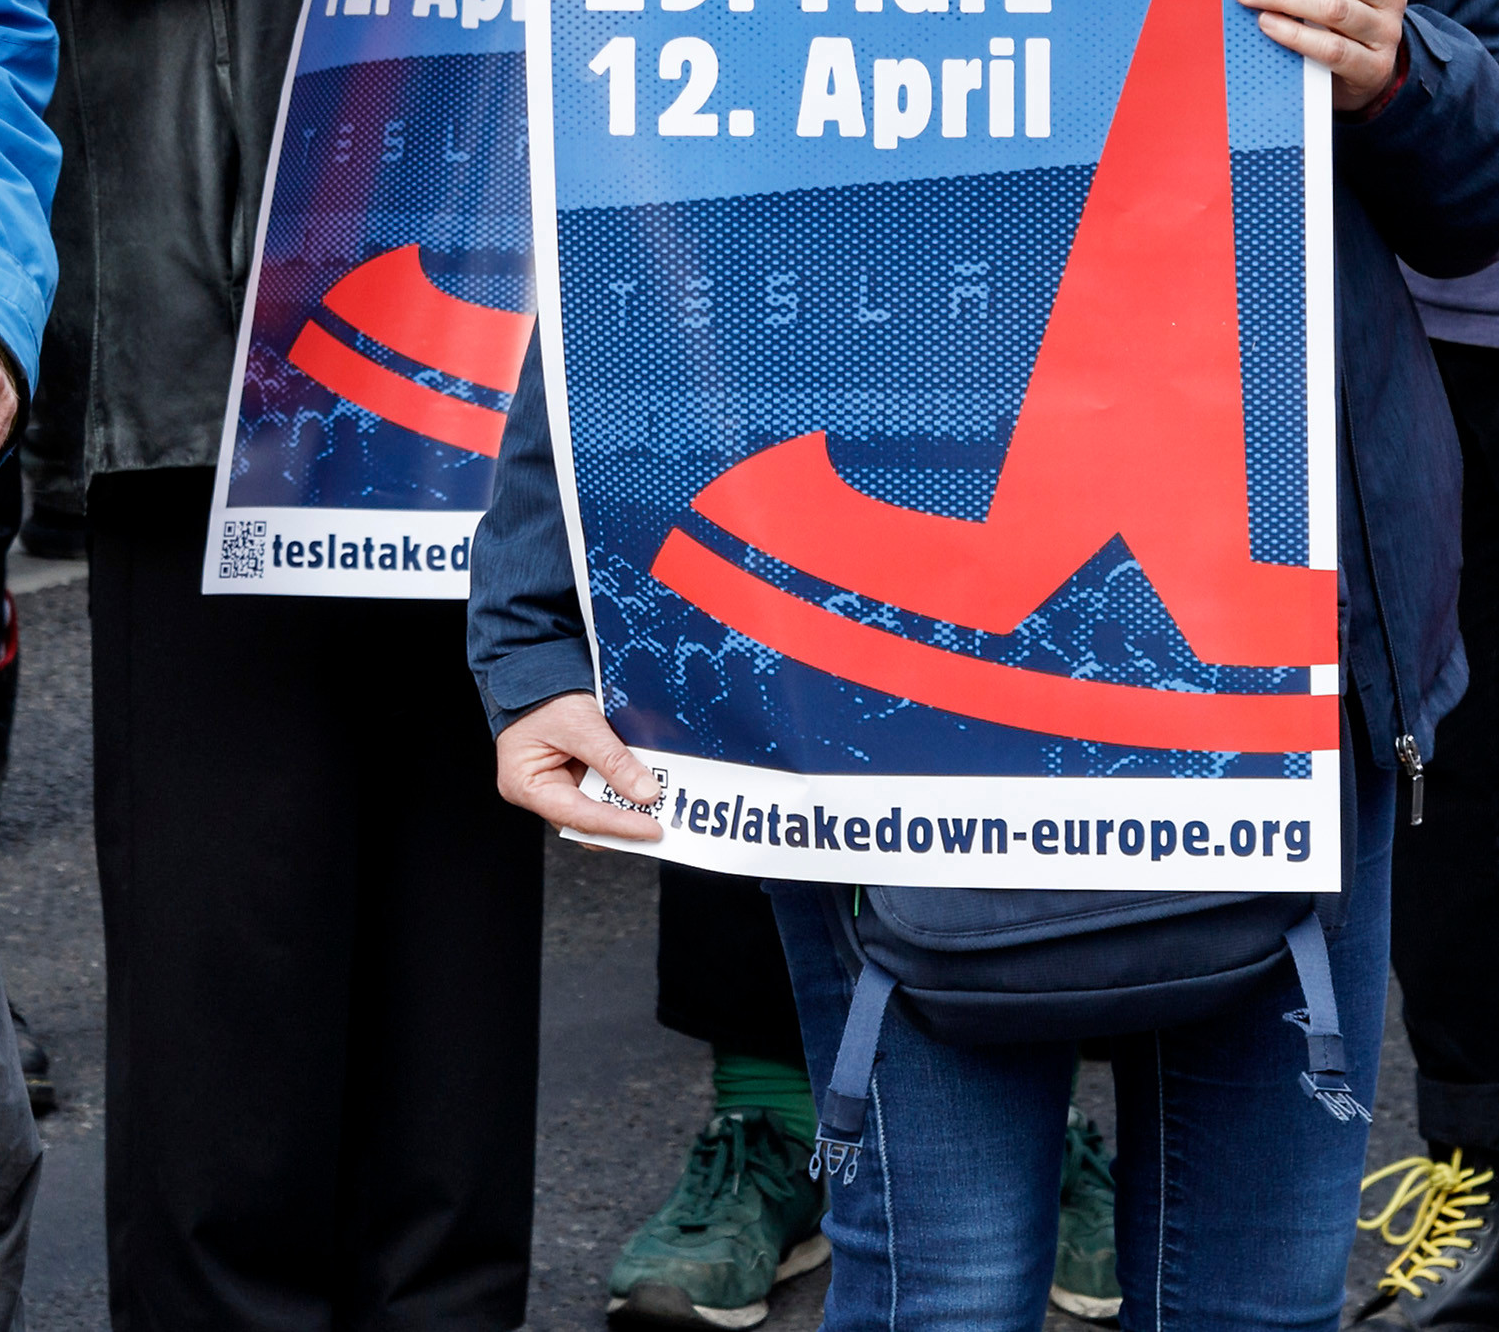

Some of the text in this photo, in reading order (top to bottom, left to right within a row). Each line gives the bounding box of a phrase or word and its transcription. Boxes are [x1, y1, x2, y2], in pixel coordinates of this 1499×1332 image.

[587, 36, 1051, 150] 12. April
[671, 787, 1312, 862] teslatakedown-europe.org
